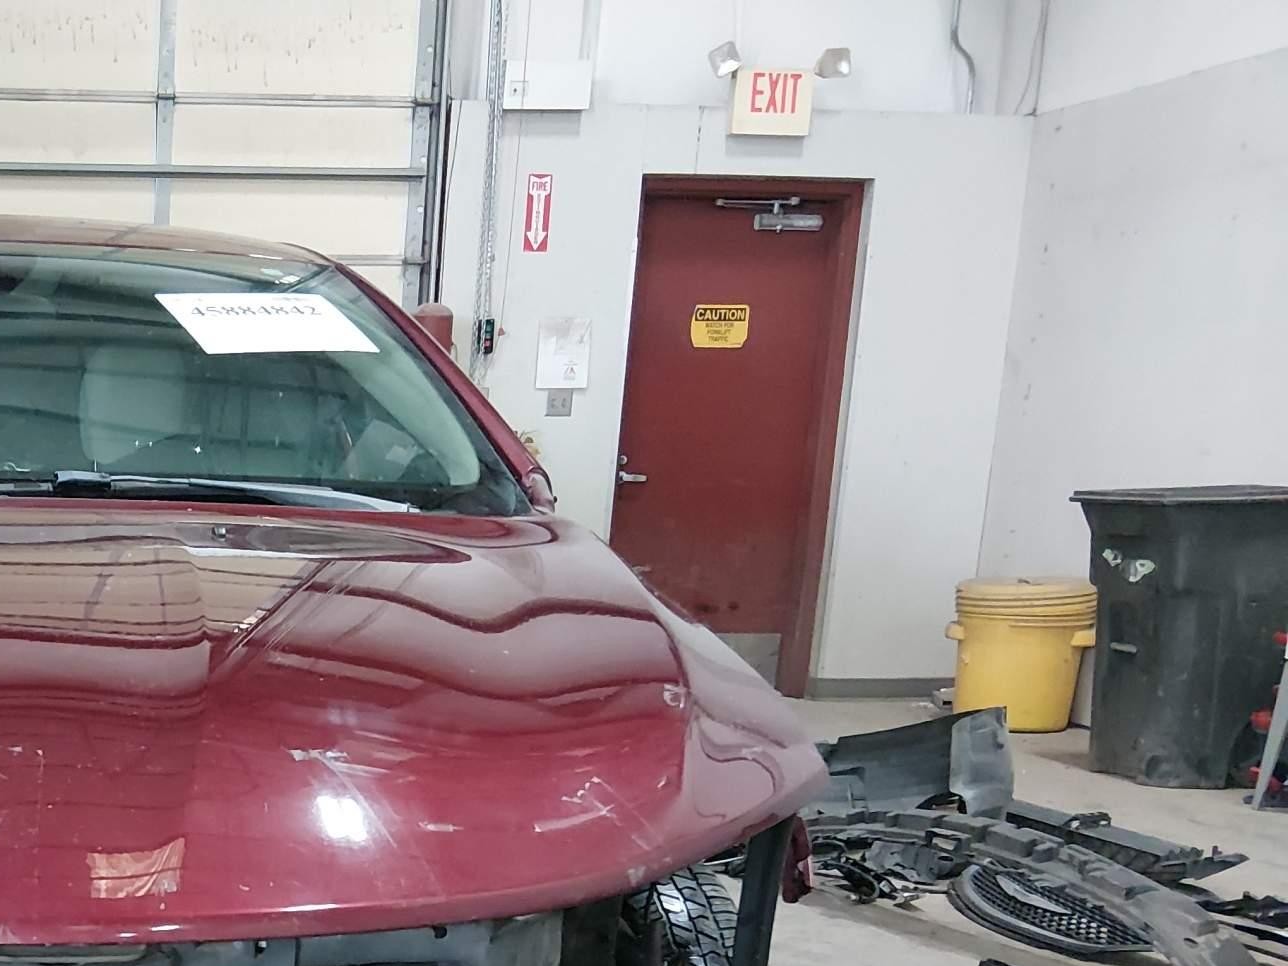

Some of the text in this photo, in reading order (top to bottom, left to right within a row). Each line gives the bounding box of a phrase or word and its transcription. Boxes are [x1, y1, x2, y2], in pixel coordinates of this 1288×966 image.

[751, 72, 802, 113] EXIT
[532, 181, 548, 191] FIRE
[696, 309, 745, 320] CAUTION
